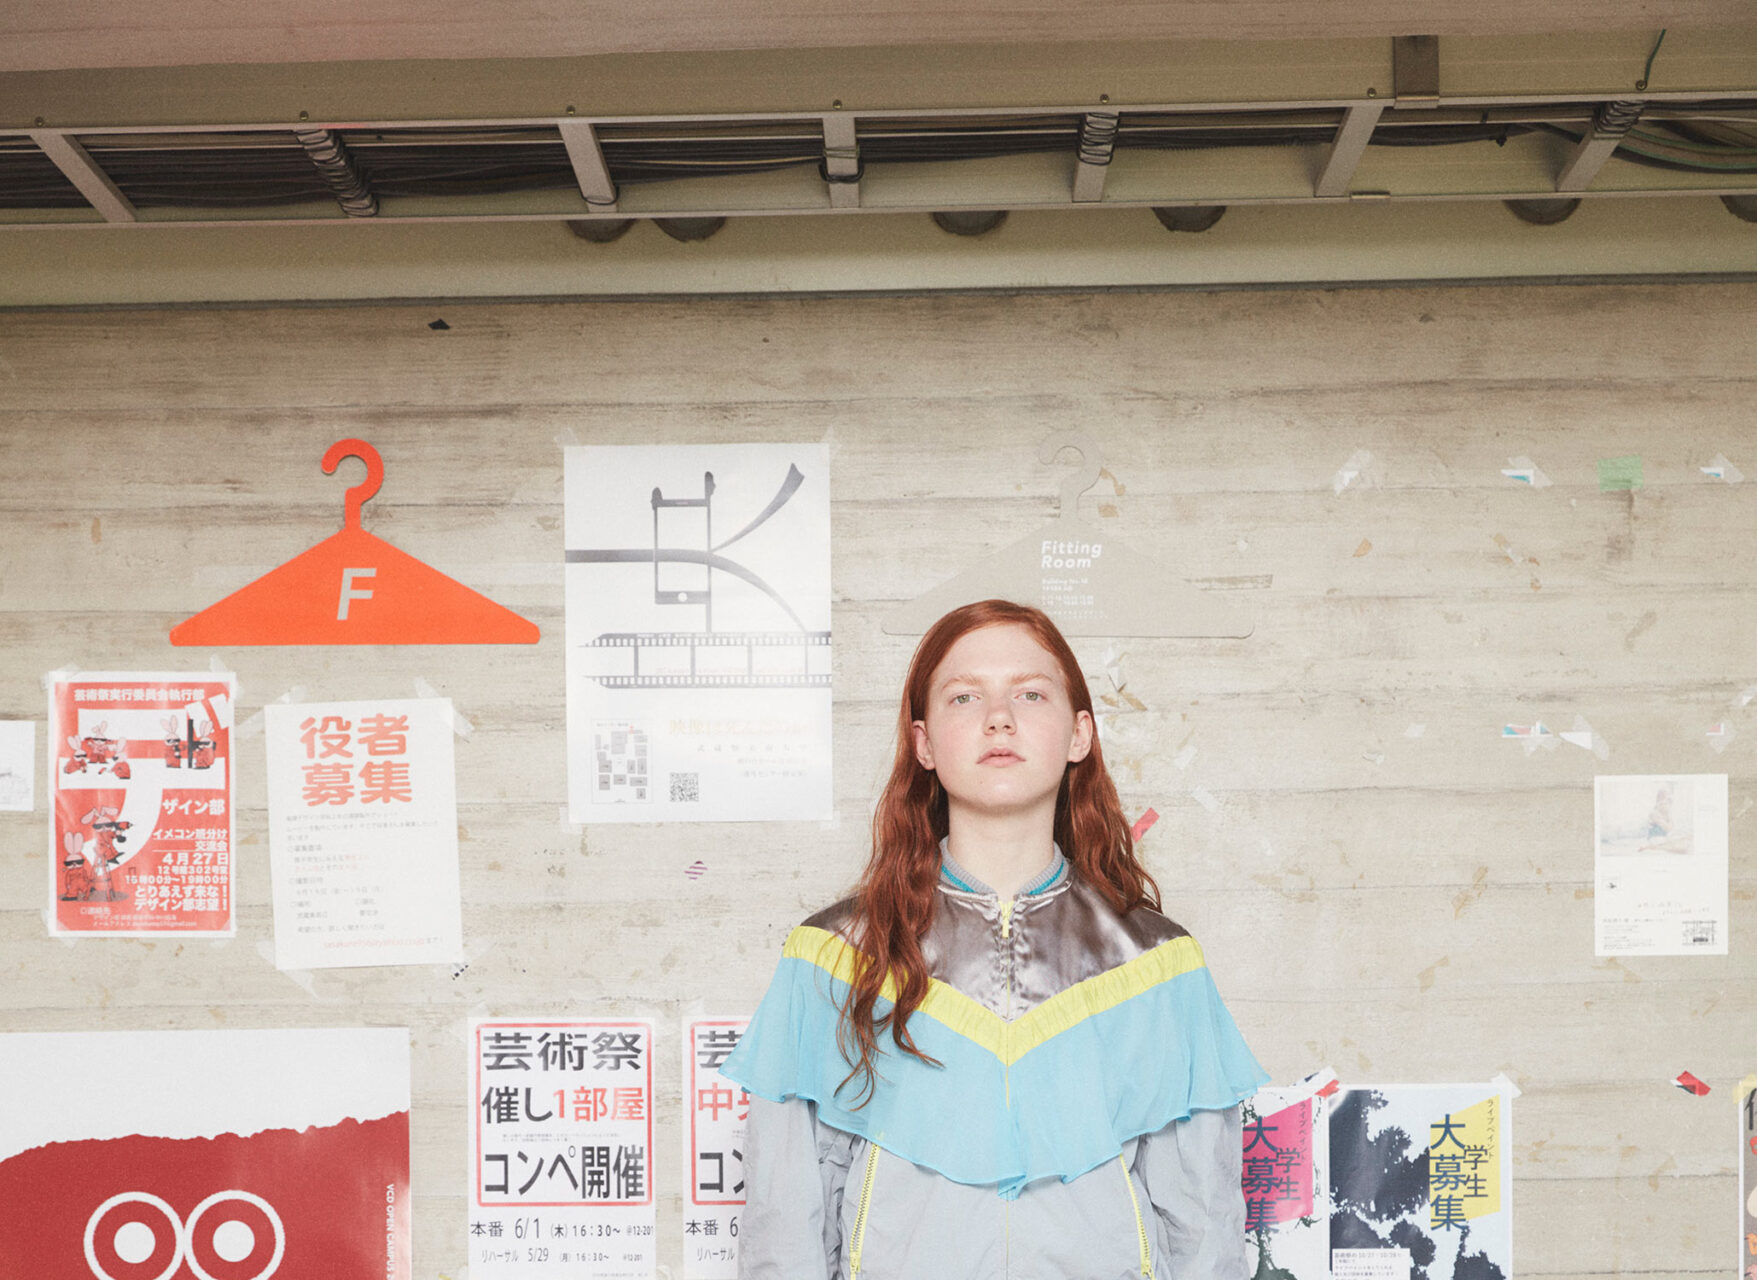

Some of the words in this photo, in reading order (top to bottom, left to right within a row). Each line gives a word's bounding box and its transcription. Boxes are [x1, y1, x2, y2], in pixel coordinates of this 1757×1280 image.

[1041, 540, 1102, 558] Fitting
[1041, 555, 1092, 569] Room
[337, 567, 377, 621] F
[299, 713, 410, 759] 役者
[301, 760, 413, 807] 募集
[162, 798, 225, 816] ザイン部
[482, 1031, 643, 1071] 芸術祭
[481, 1085, 646, 1124] 催し1部屋
[484, 1144, 645, 1200] コンペ開催
[1242, 1115, 1280, 1235] 大募集
[1275, 1147, 1302, 1201] 学生
[1429, 1113, 1468, 1232] 大募集
[1463, 1144, 1489, 1198] 学生
[386, 1183, 395, 1203] VCD
[386, 1205, 395, 1231] OPEN
[470, 1220, 504, 1238] 本番
[514, 1216, 541, 1240] 6/1
[685, 1219, 719, 1236] 本番
[729, 1216, 738, 1237] 6
[386, 1232, 395, 1272] CAMPUS
[480, 1249, 519, 1264] リハーサル
[527, 1247, 550, 1263] 5/29
[696, 1246, 736, 1262] リハーサル
